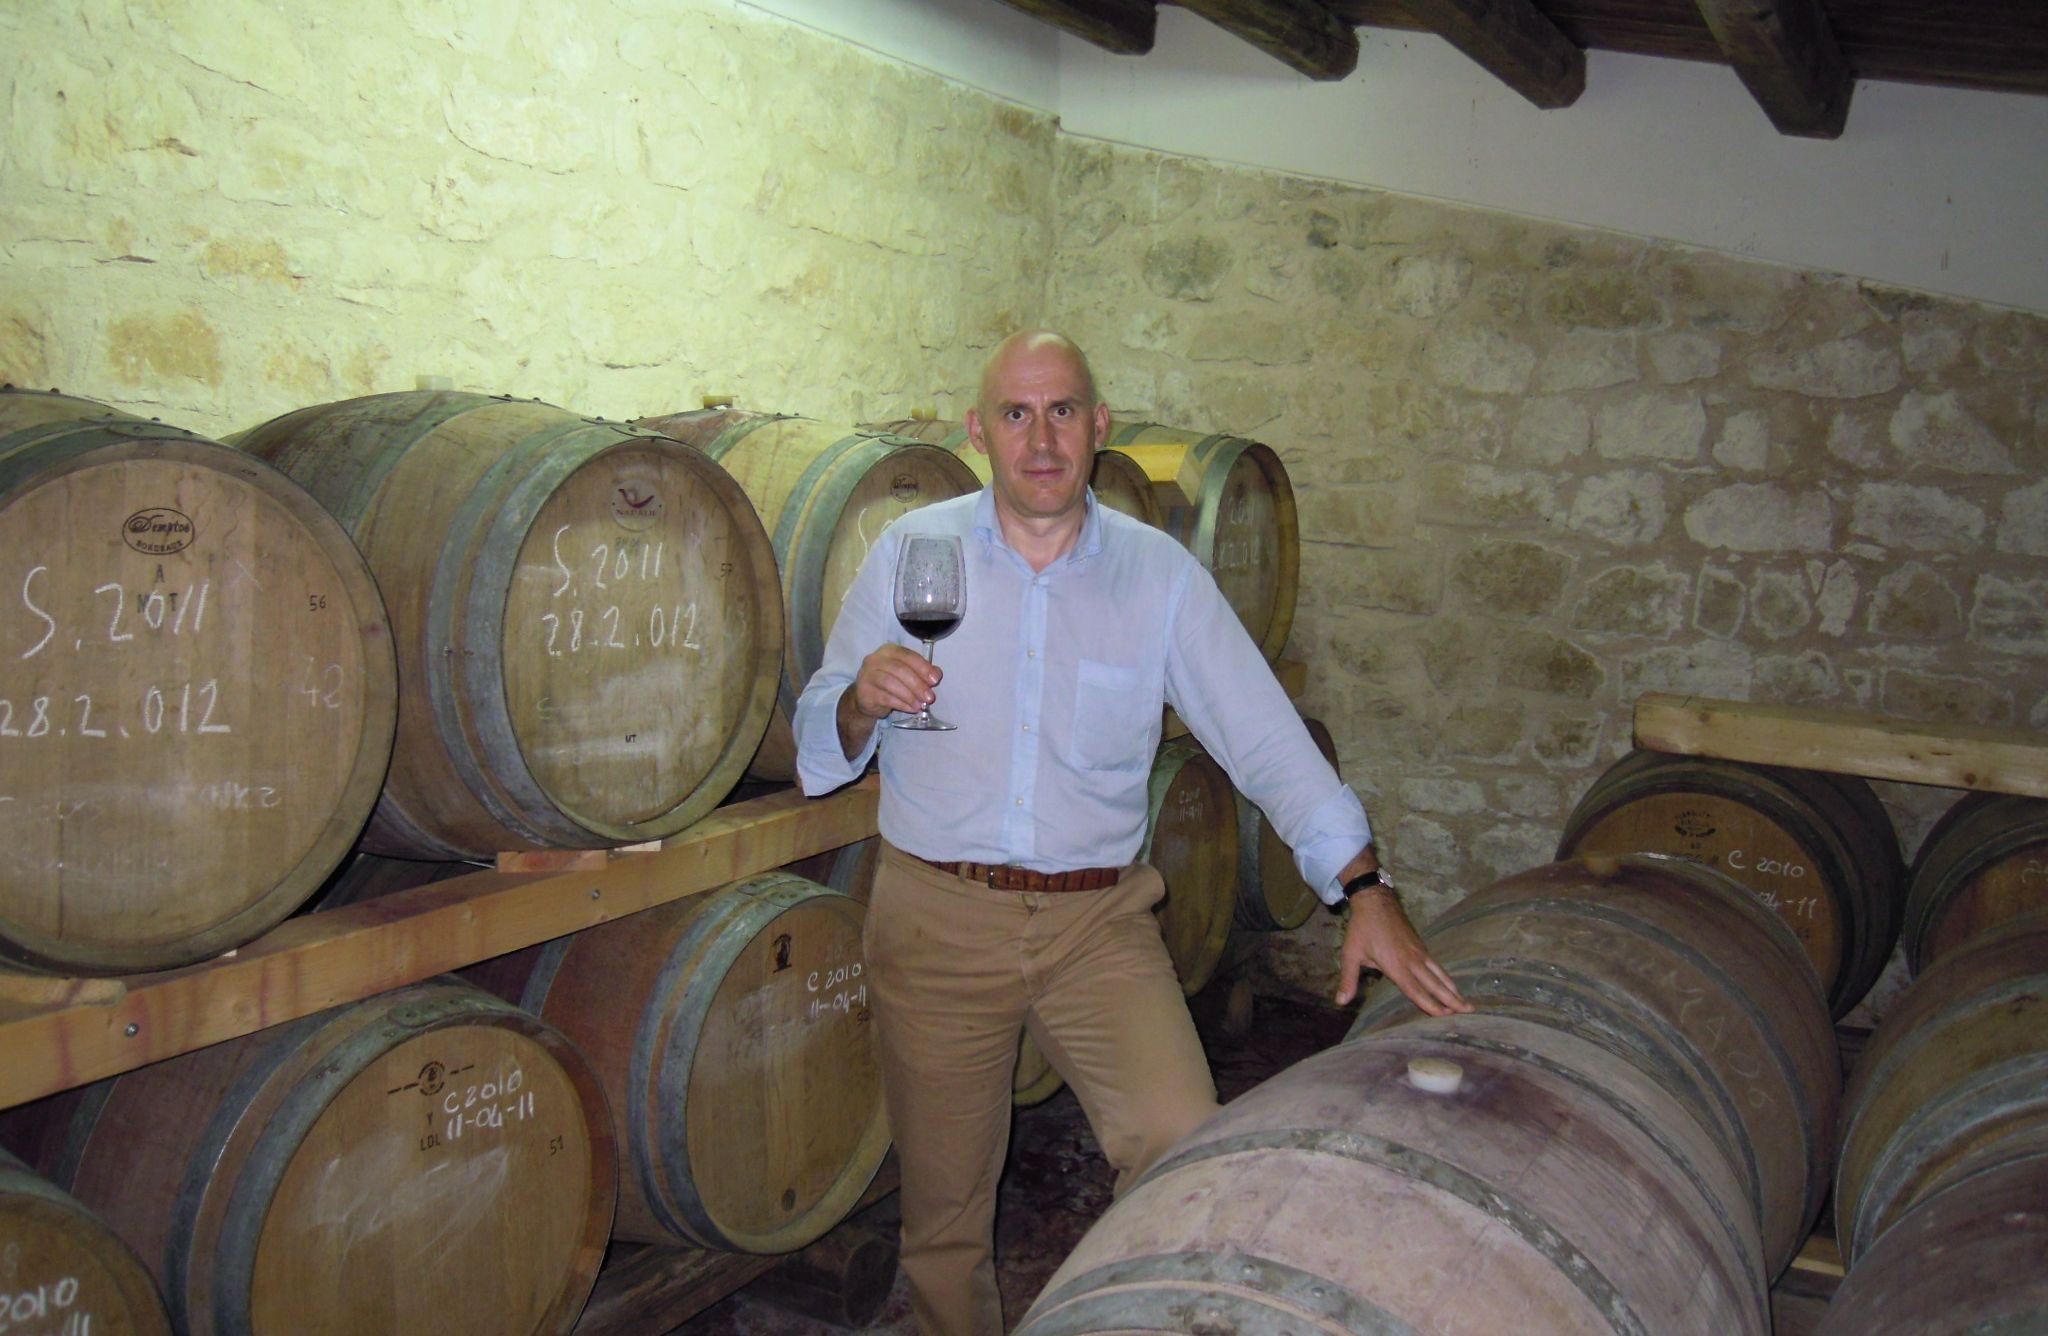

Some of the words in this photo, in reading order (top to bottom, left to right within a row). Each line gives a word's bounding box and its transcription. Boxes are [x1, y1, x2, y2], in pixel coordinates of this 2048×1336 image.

[592, 542, 663, 589] 2011
[95, 579, 209, 642] 2011
[309, 595, 327, 611] 56
[541, 603, 700, 656] 28.2.012
[0, 678, 231, 738] 28.2.012
[1728, 850, 1745, 869] C
[1756, 857, 1804, 878] 2010
[807, 971, 819, 992] C
[825, 963, 862, 989] 2010
[810, 984, 866, 1017] 11-04-11
[444, 1091, 459, 1113] C
[464, 1069, 522, 1108] 2010
[447, 1091, 535, 1139] 11-04-11
